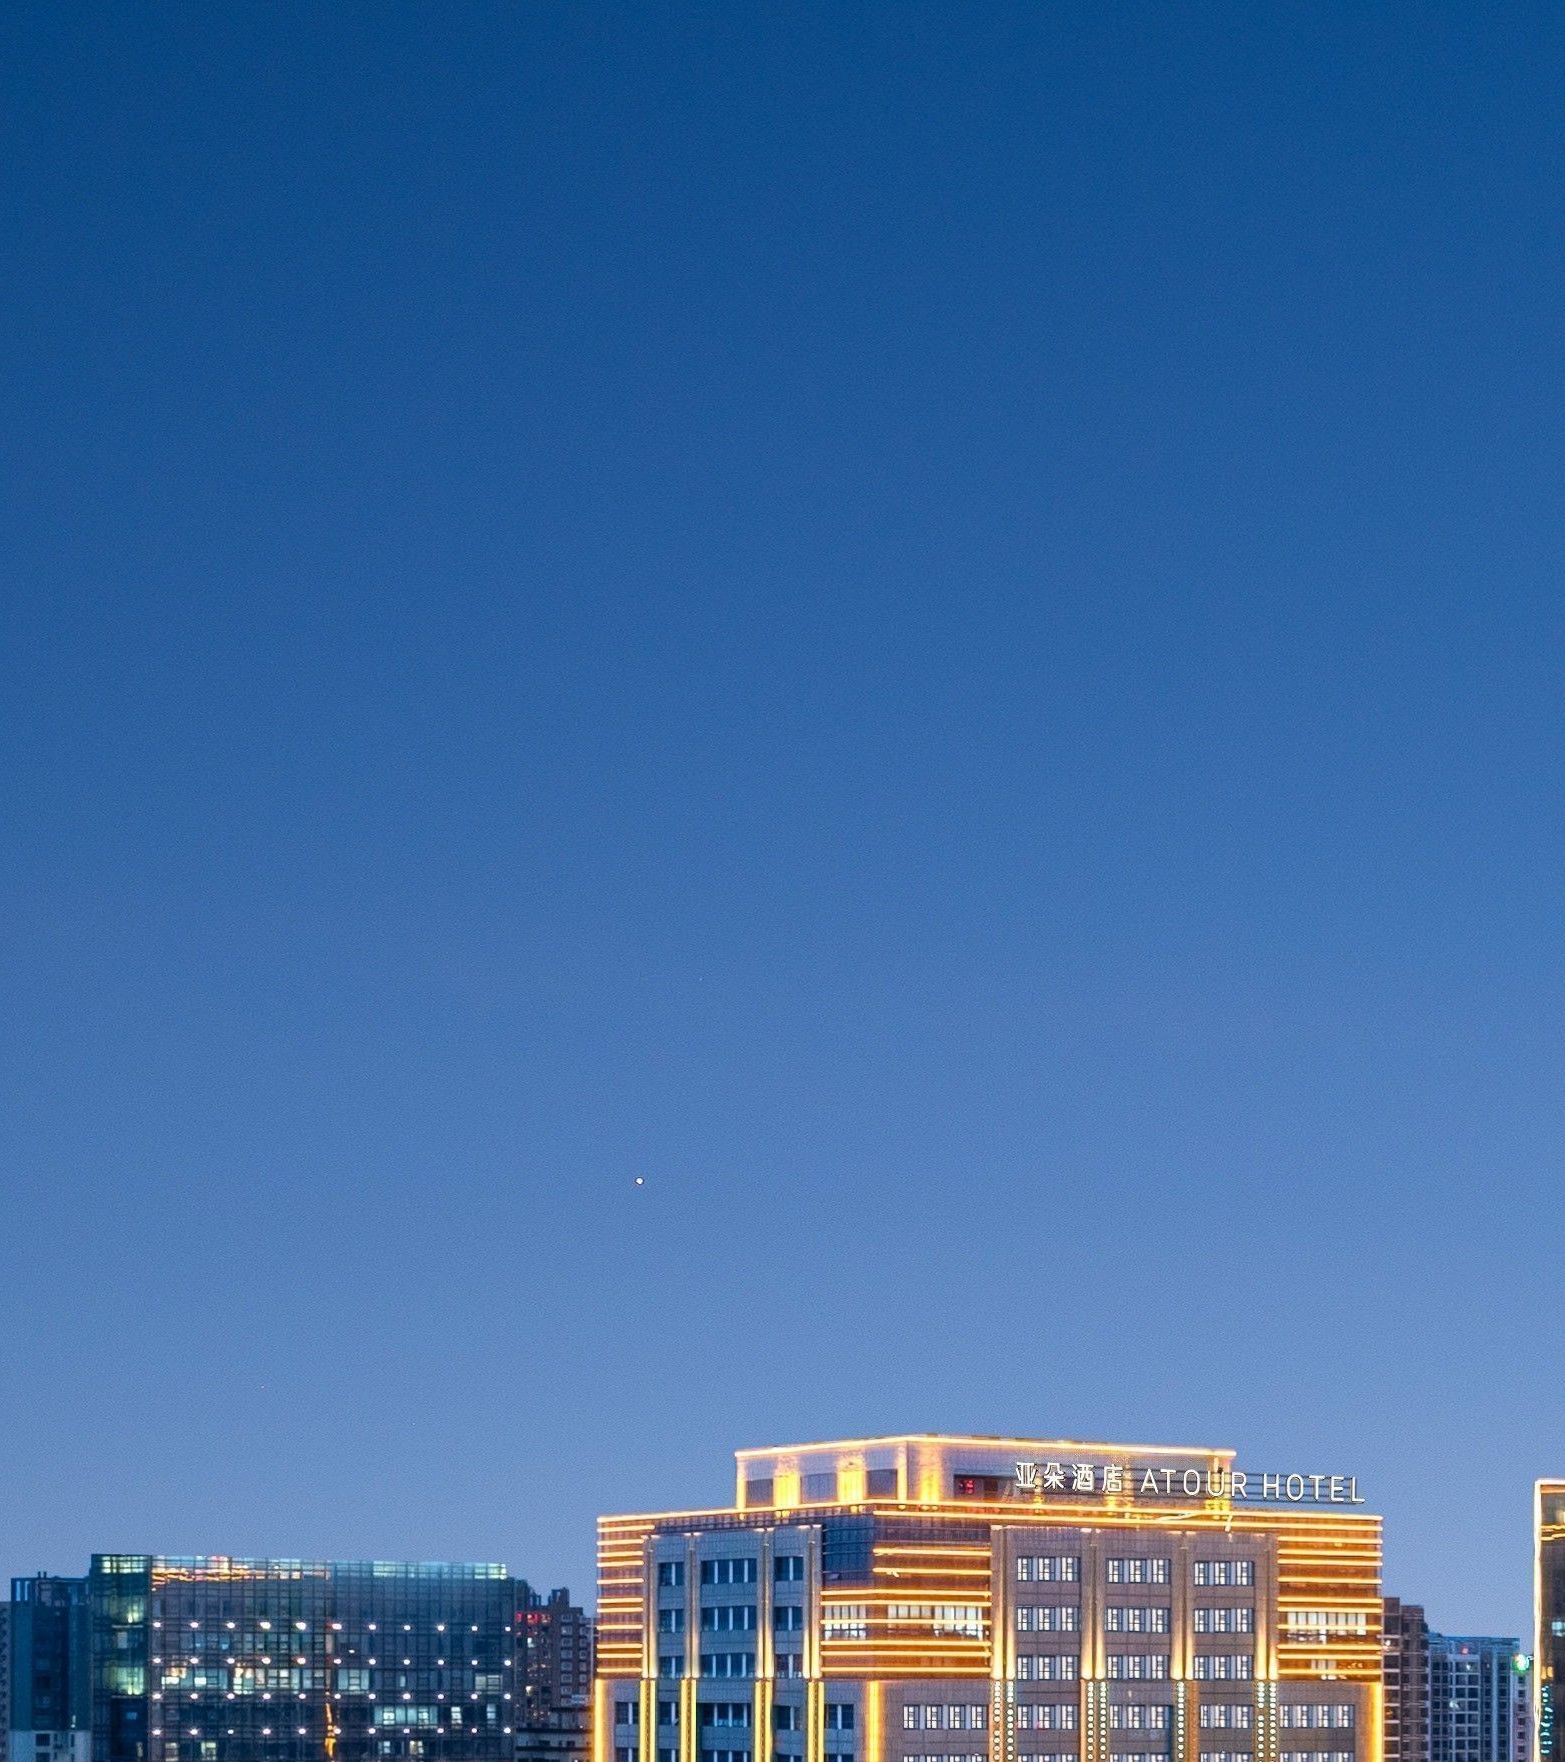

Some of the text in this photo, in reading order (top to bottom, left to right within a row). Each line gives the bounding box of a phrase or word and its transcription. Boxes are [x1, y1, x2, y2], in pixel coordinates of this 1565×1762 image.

[1015, 1462, 1123, 1493] 亚朵酒店
[1140, 1469, 1366, 1503] ATOUR HOTEL
